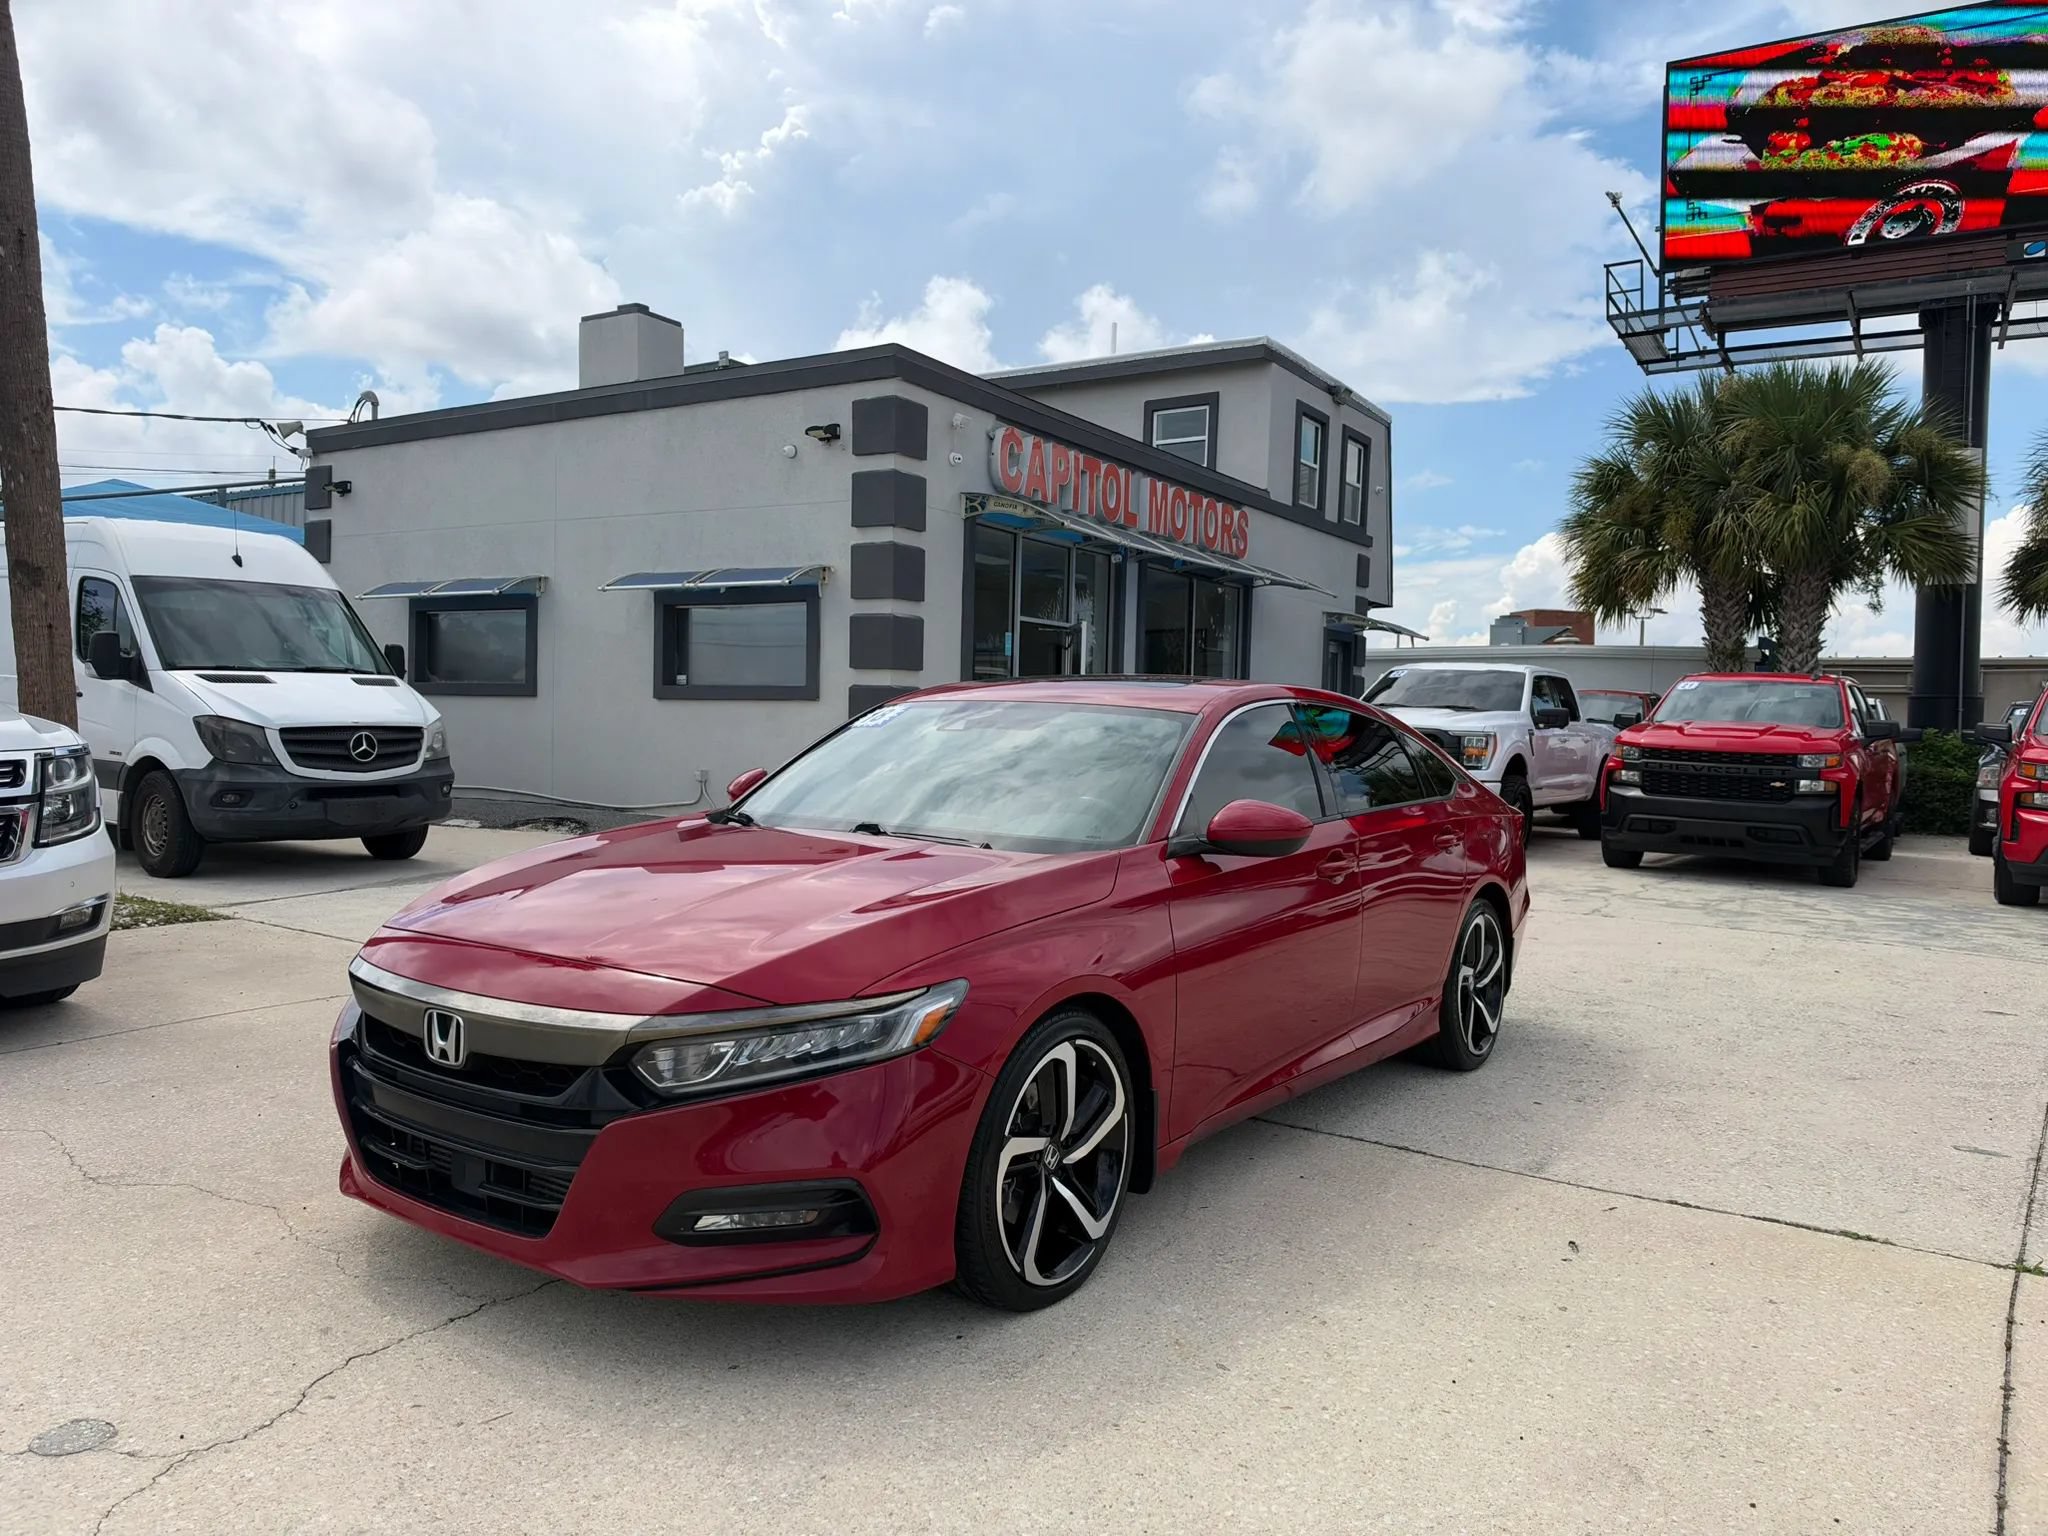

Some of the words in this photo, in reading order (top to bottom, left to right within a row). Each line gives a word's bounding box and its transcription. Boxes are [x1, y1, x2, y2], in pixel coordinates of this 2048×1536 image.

[997, 426, 1140, 529] CAPITOL
[1147, 477, 1250, 560] MOTORS
[1644, 761, 1792, 776] CHEVROLET
